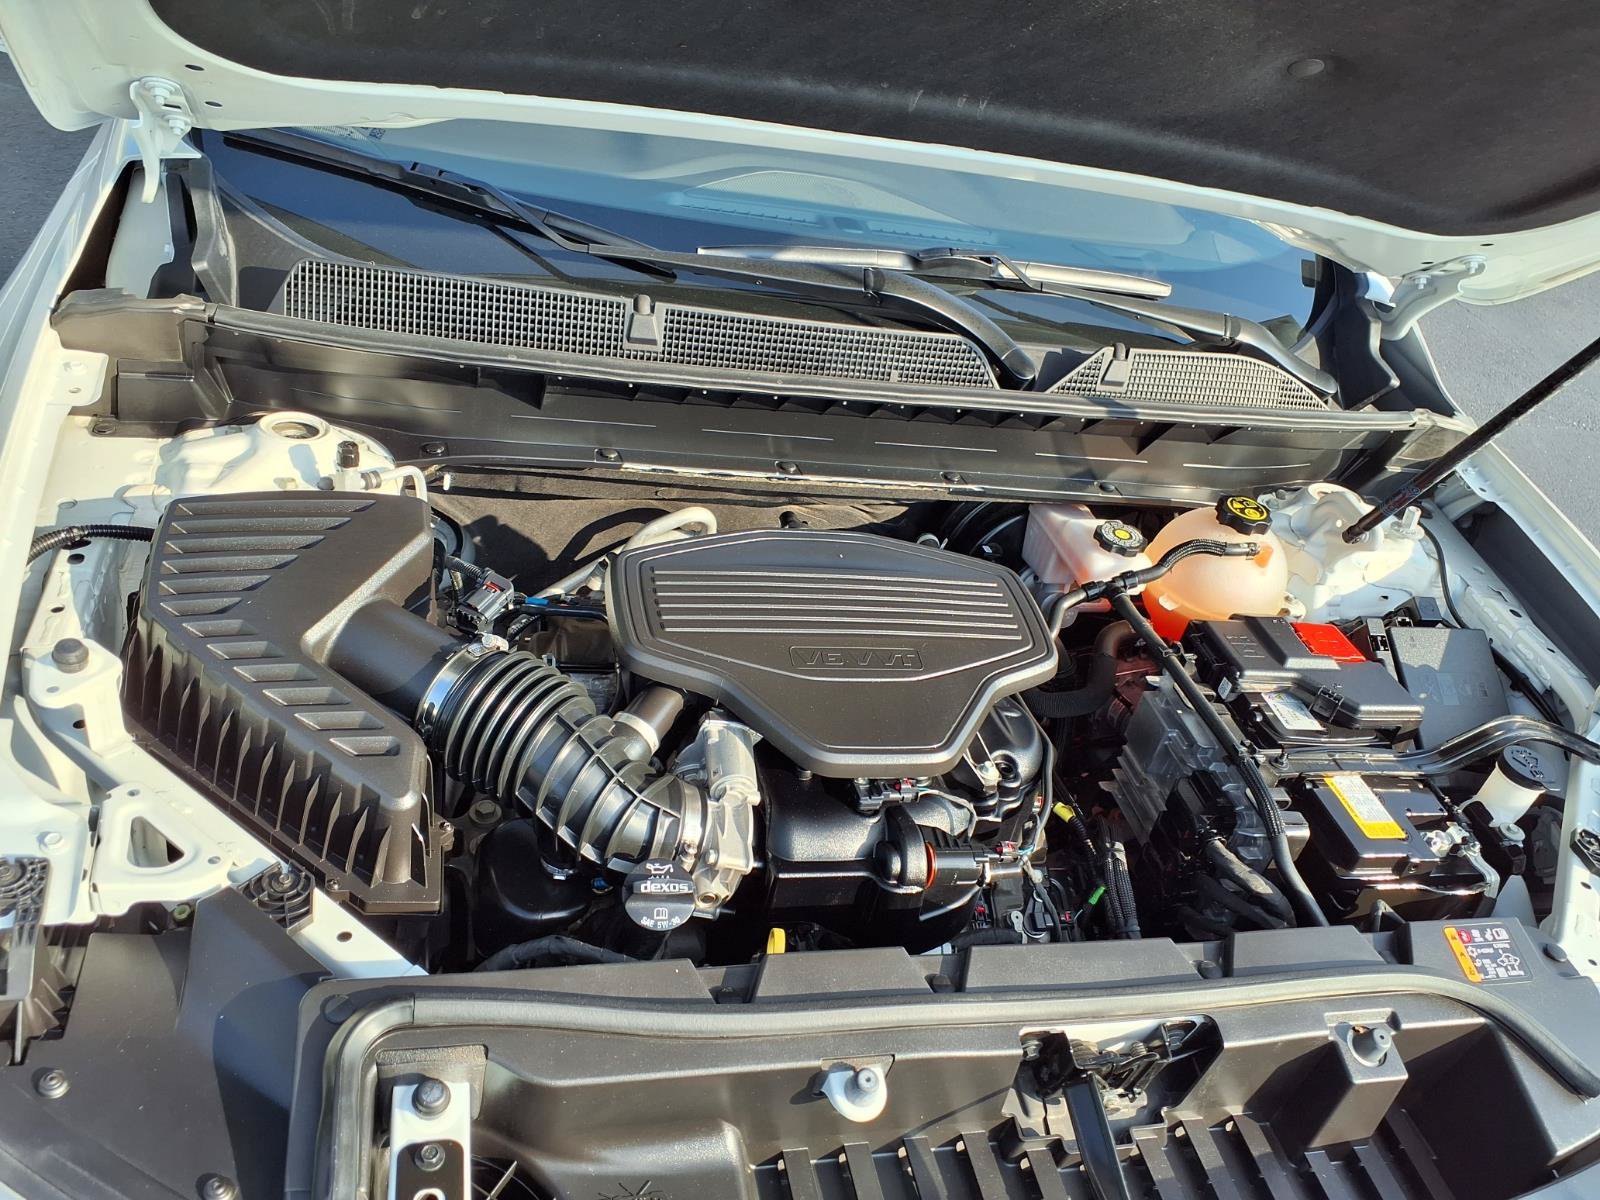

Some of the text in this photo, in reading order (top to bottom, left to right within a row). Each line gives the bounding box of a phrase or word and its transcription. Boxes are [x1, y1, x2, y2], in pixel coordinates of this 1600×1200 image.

[640, 880, 689, 893] dexos
[640, 916, 680, 929] SAE 5W-30
